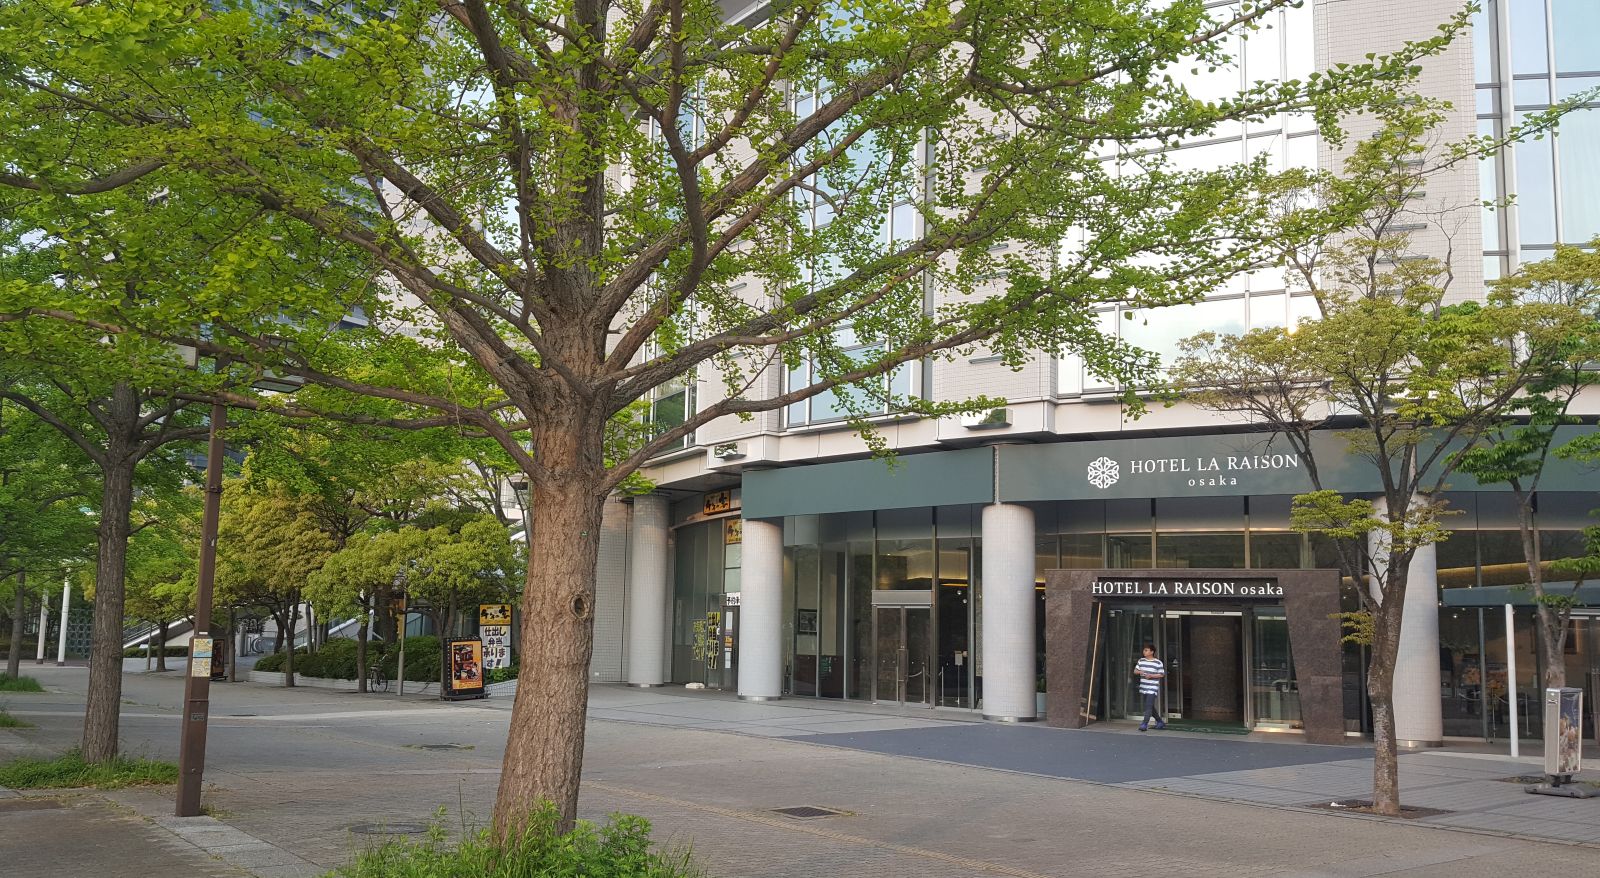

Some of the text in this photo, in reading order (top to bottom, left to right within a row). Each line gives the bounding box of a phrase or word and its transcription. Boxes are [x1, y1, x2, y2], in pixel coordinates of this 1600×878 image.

[1130, 453, 1298, 474] HOTEL LA RAISON
[1188, 474, 1237, 487] osaka
[1092, 581, 1283, 595] HOTEL LA RAISON osaka
